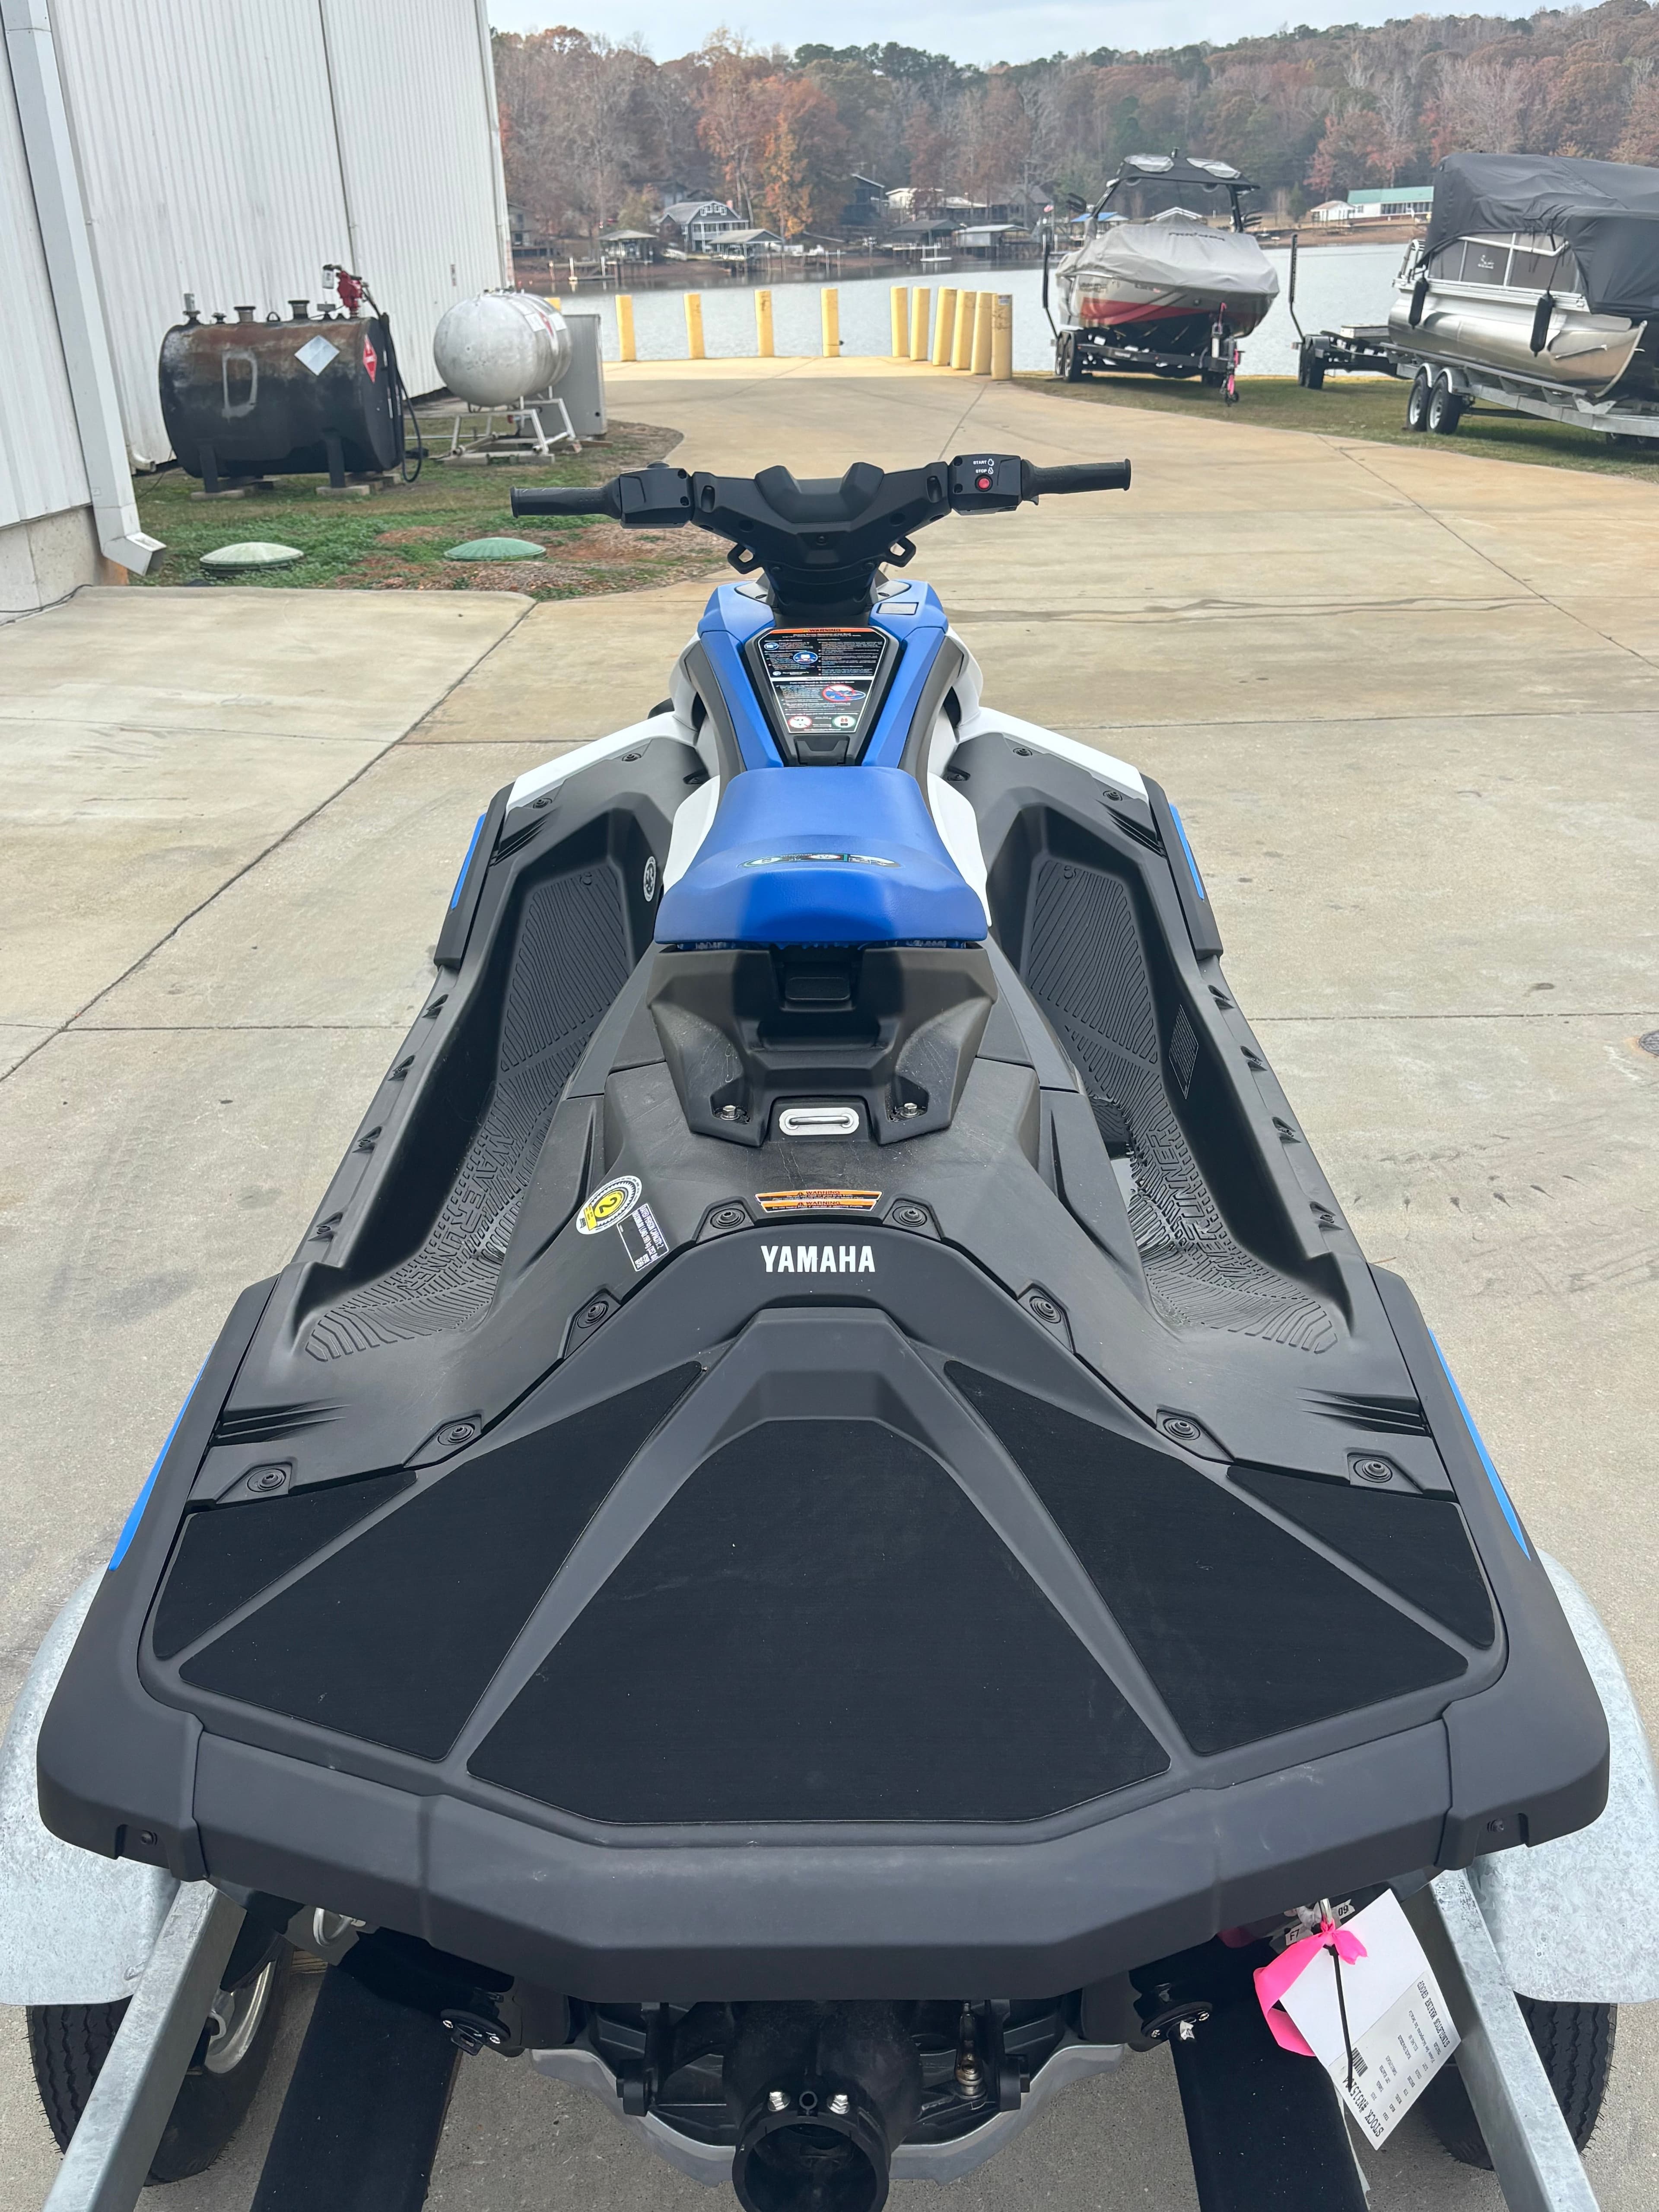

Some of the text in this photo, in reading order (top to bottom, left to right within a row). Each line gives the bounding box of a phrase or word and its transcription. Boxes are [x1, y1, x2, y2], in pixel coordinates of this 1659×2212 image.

[599, 1197, 618, 1214] 2
[761, 1246, 875, 1272] YAMAHA
[1338, 1905, 1348, 1916] 09
[1417, 1980, 1449, 2047] SINGLETON MARINE GROUP
[1364, 2109, 1383, 2136] STOCK
